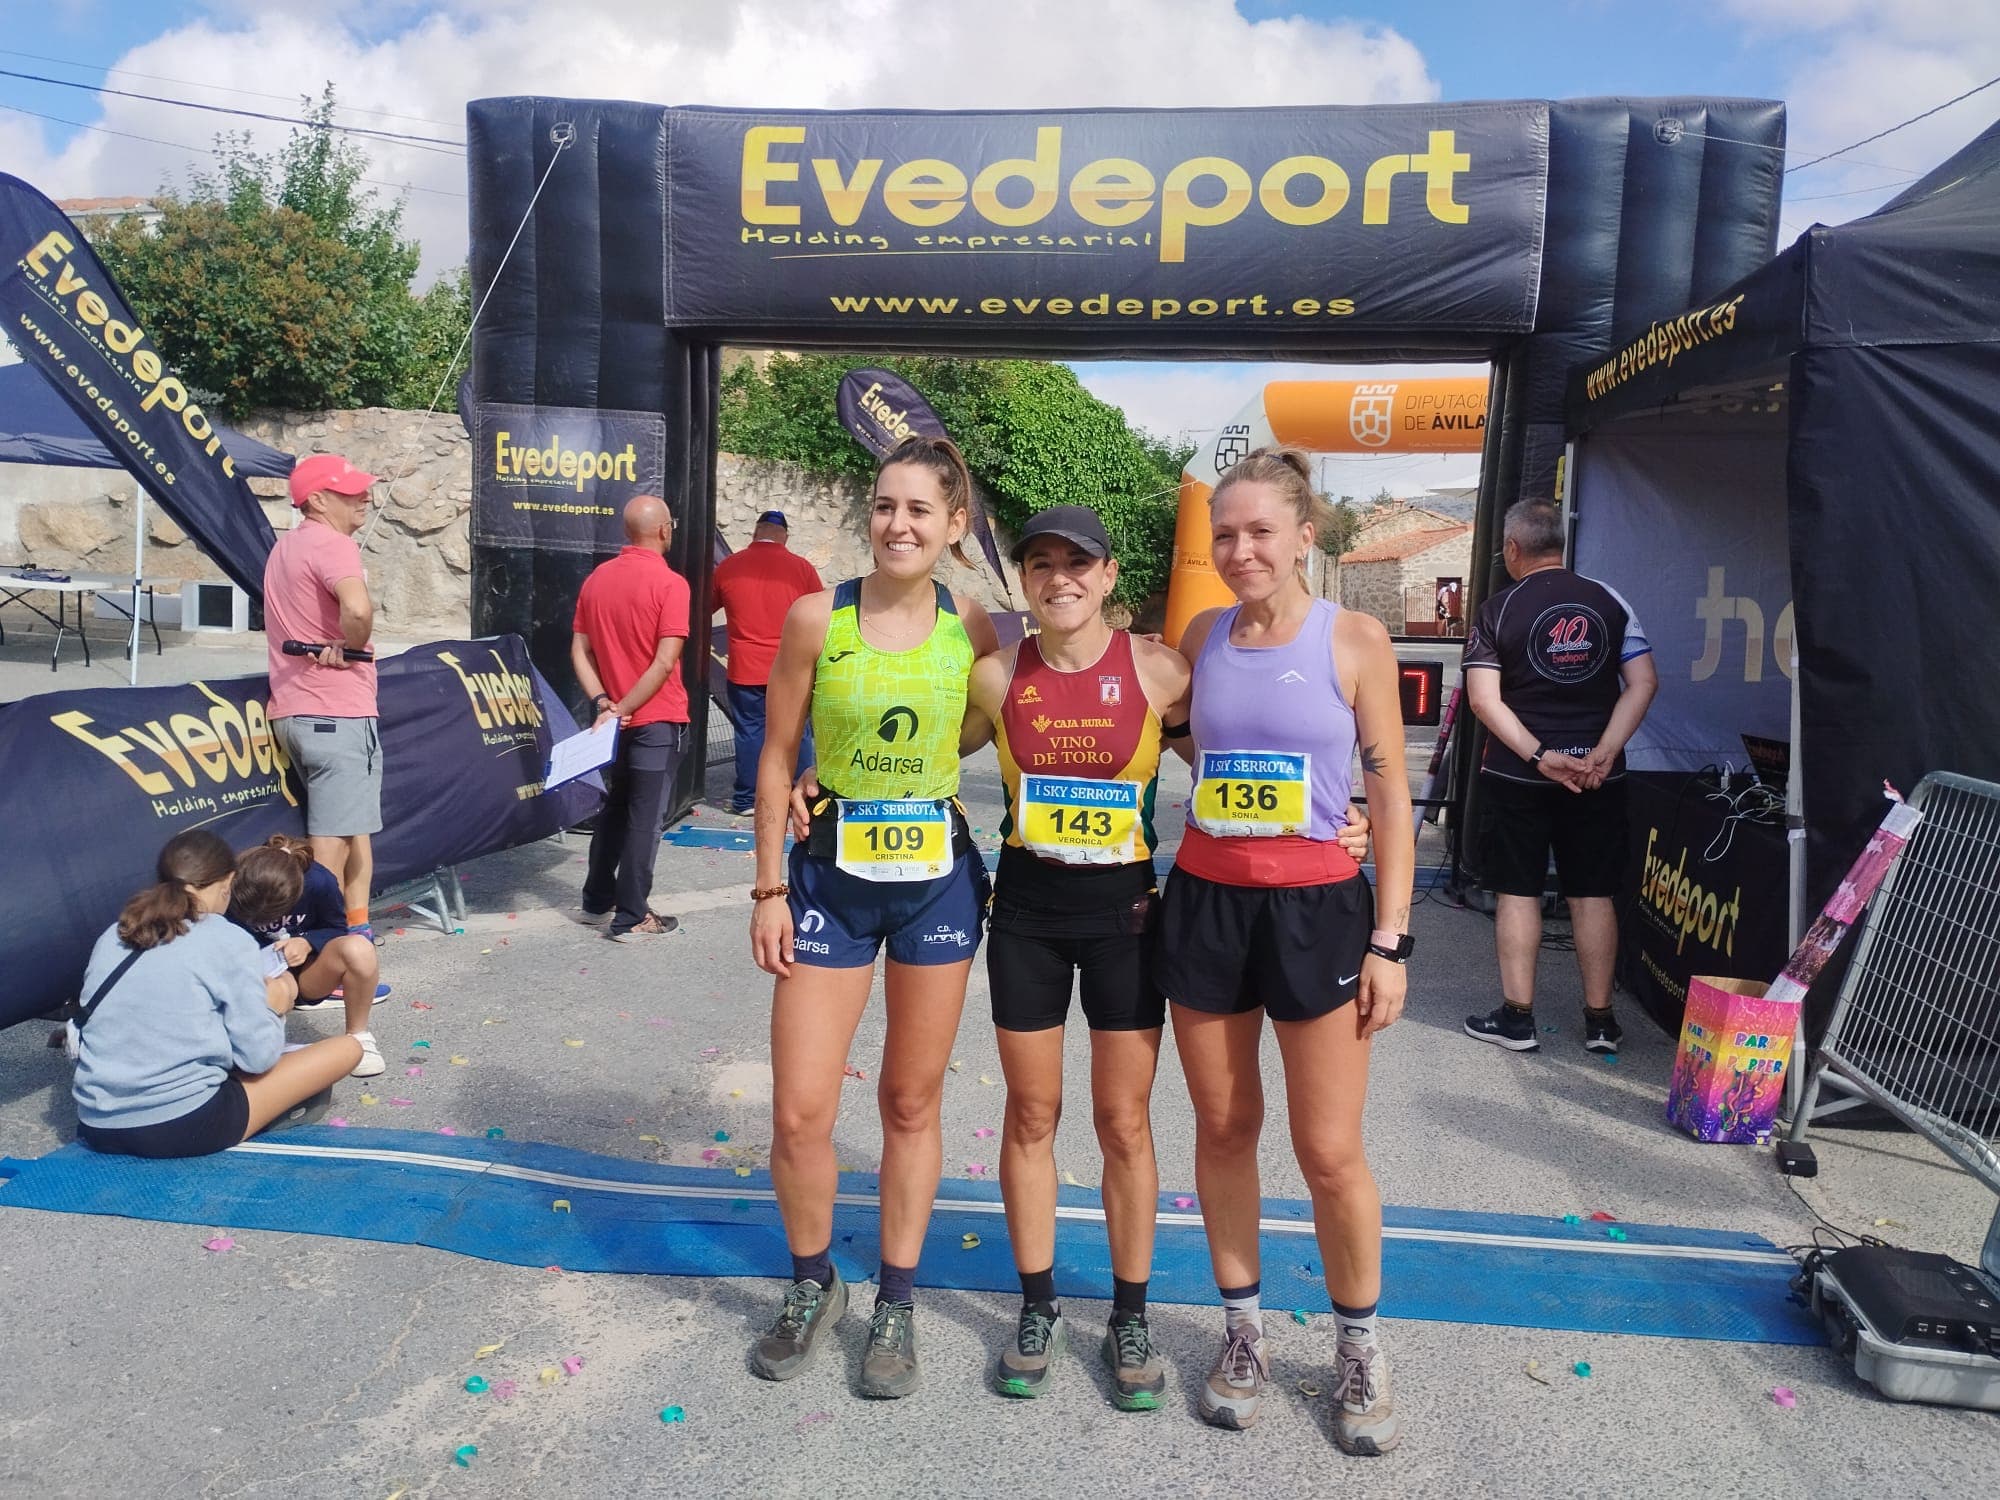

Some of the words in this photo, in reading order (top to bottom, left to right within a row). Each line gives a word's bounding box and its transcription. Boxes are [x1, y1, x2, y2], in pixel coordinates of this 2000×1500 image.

[741, 126, 1471, 263] Evedeport
[741, 228, 889, 250] Holding
[914, 231, 1152, 249] empresarial
[830, 293, 1356, 319] www.evedeport.es
[17, 260, 68, 315] Holding
[75, 319, 148, 396] empresarial
[1586, 294, 1745, 400] www.evedeport.es
[20, 313, 176, 485] www.evedeport.es
[1405, 415, 1427, 431] DE
[1432, 412, 1485, 430] ÁVILA
[496, 432, 636, 492] Evedeport
[512, 501, 615, 516] www.evedeport.es
[1549, 616, 1588, 646] 10
[1552, 651, 1589, 664] Evedeport
[1404, 671, 1427, 714] 7
[1053, 720, 1078, 729] CAJA
[1081, 718, 1114, 728] RURAL
[1049, 736, 1096, 749] VINO
[851, 749, 923, 774] Adarsa
[1033, 753, 1057, 766] DE
[1061, 751, 1113, 764] TORO
[1233, 760, 1296, 774] SERROTA
[151, 794, 217, 819] Holding
[222, 779, 281, 805] empresarial
[1035, 785, 1040, 795] I
[1043, 785, 1068, 798] SKY
[1071, 787, 1130, 802] SERROTA
[1216, 783, 1278, 811] 136
[858, 804, 879, 815] SKY
[881, 803, 938, 815] SERROTA
[1050, 809, 1112, 836] 143
[865, 826, 924, 851] 109
[1058, 837, 1102, 845] VERONICA
[1641, 827, 1740, 958] Evedeport
[252, 914, 306, 932] UCKY
[793, 936, 829, 954] darsa
[1734, 1032, 1789, 1050] PARTY
[1726, 1055, 1783, 1073] POPPER
